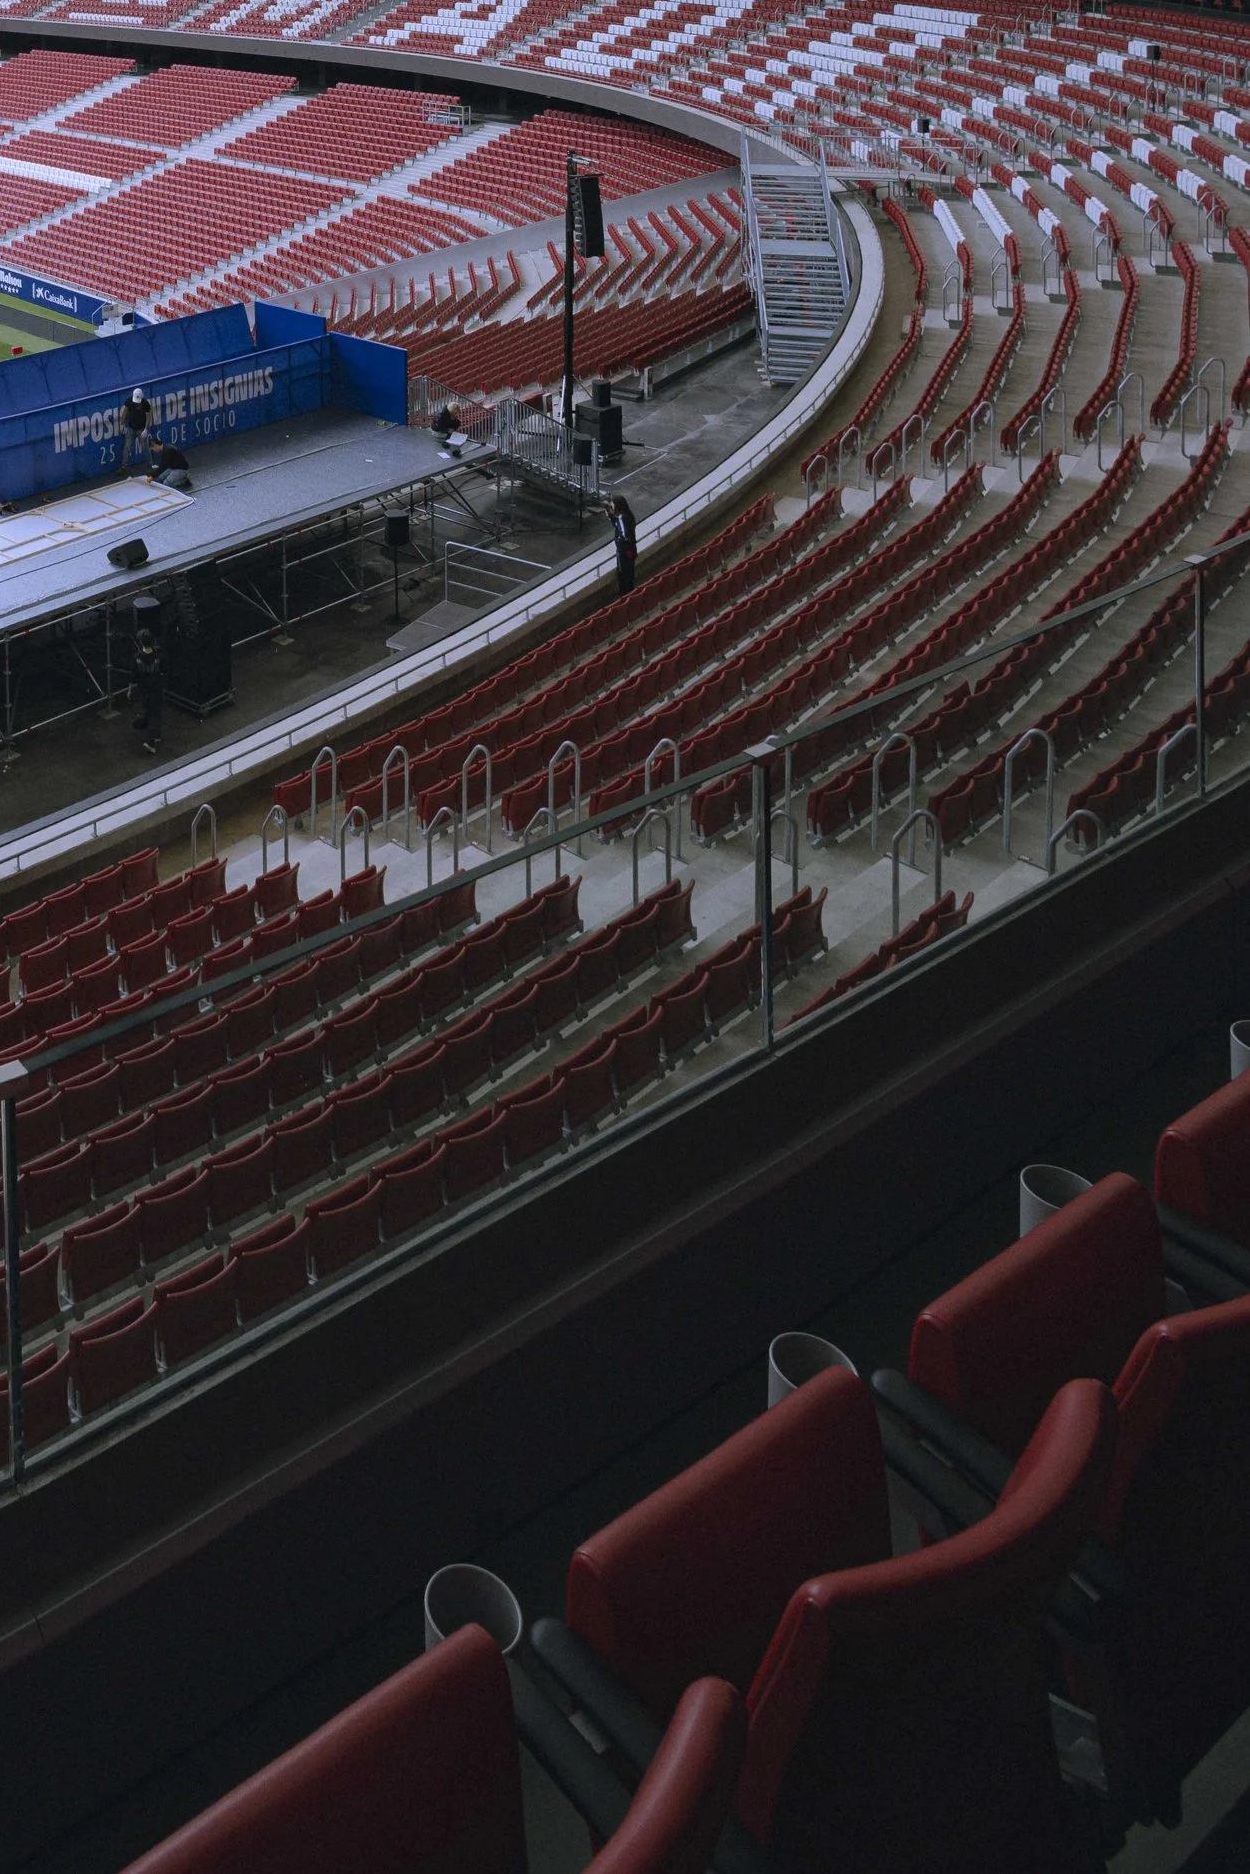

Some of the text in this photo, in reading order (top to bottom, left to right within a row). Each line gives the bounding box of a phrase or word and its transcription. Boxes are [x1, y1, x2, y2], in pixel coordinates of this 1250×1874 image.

[44, 289, 74, 310] CaixaBank
[165, 389, 187, 422] DE
[190, 366, 274, 415] INSIGNIAS
[100, 443, 116, 465] 25
[171, 423, 187, 445] DE
[195, 409, 236, 438] SOCIO
